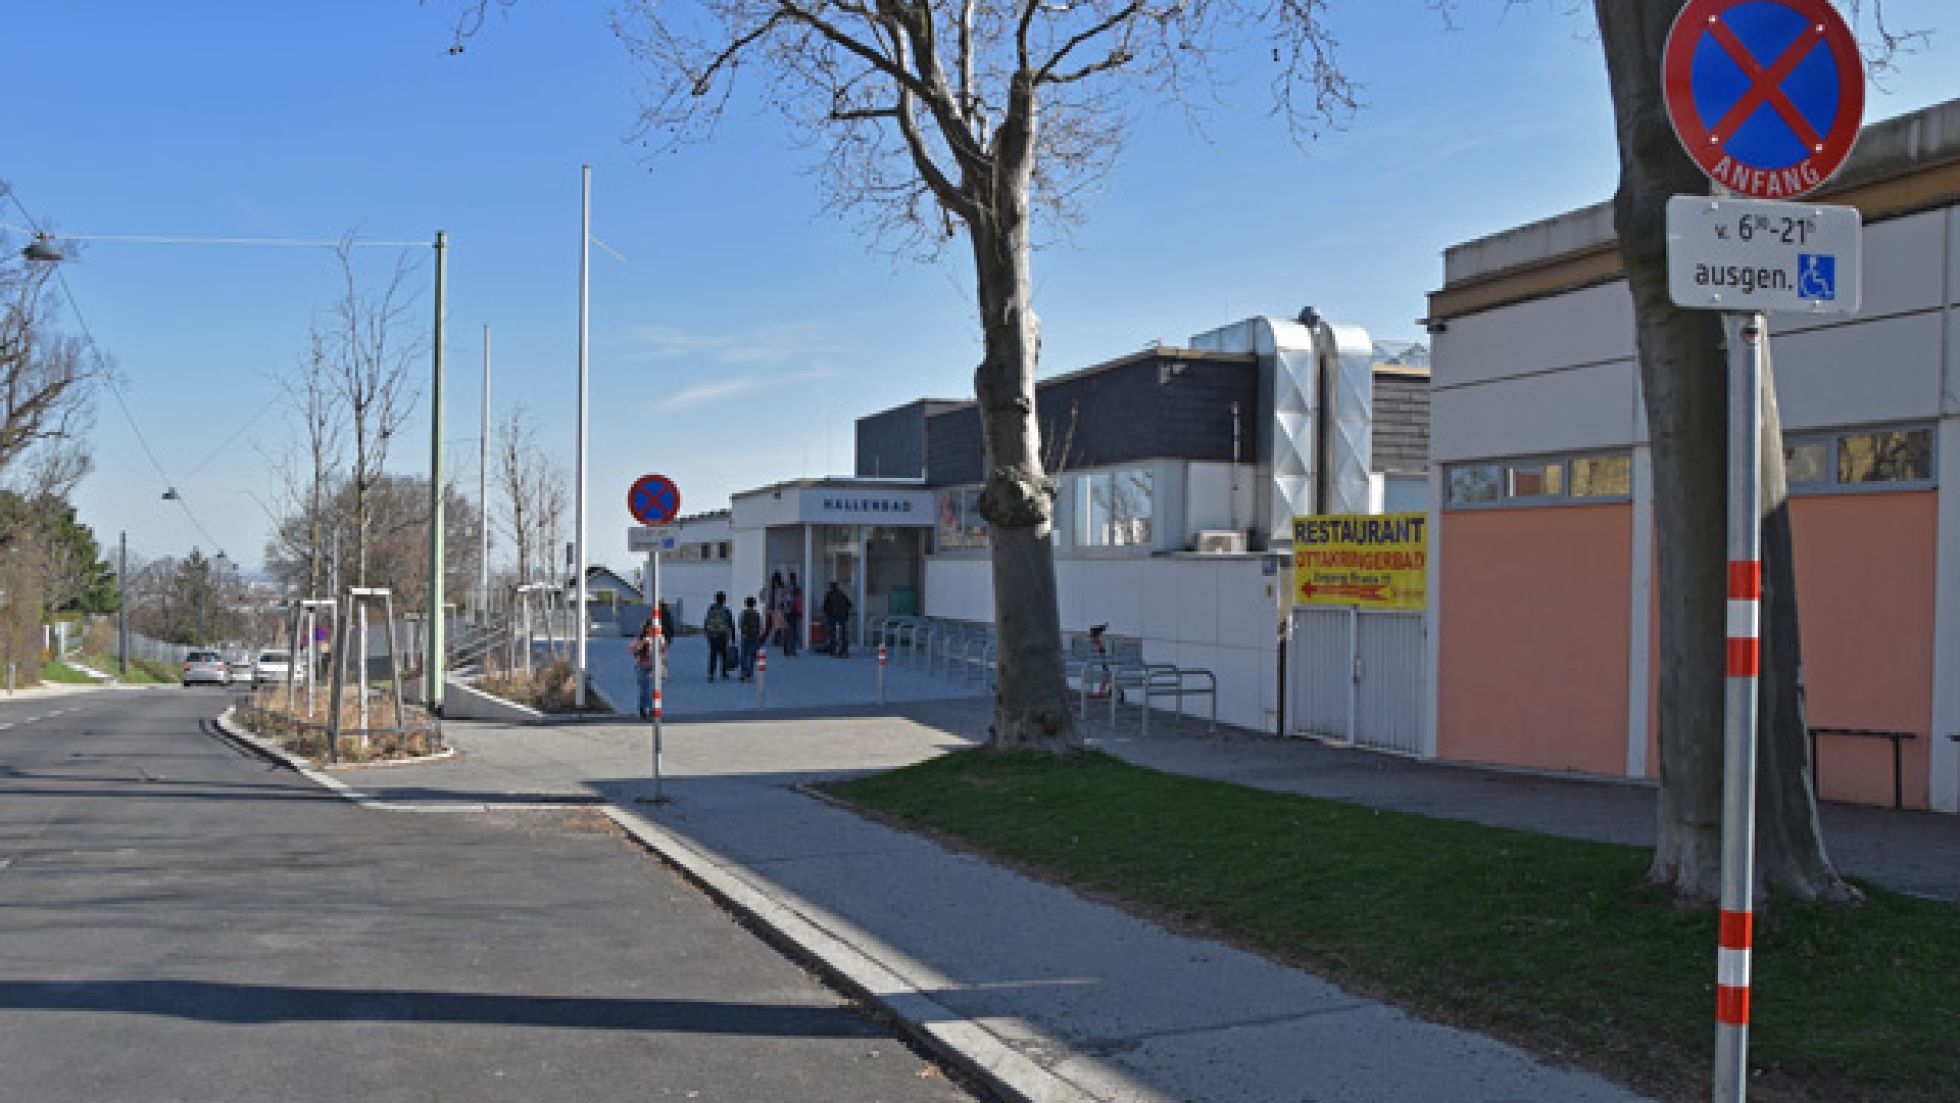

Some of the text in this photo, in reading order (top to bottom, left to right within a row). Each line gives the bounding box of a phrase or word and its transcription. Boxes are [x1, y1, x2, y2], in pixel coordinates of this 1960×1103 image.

[1712, 155, 1820, 196] ANFANG
[1694, 263, 1794, 294] ausgen.
[823, 498, 911, 513] HALLENBAD
[1294, 517, 1425, 545] RESTAURANT
